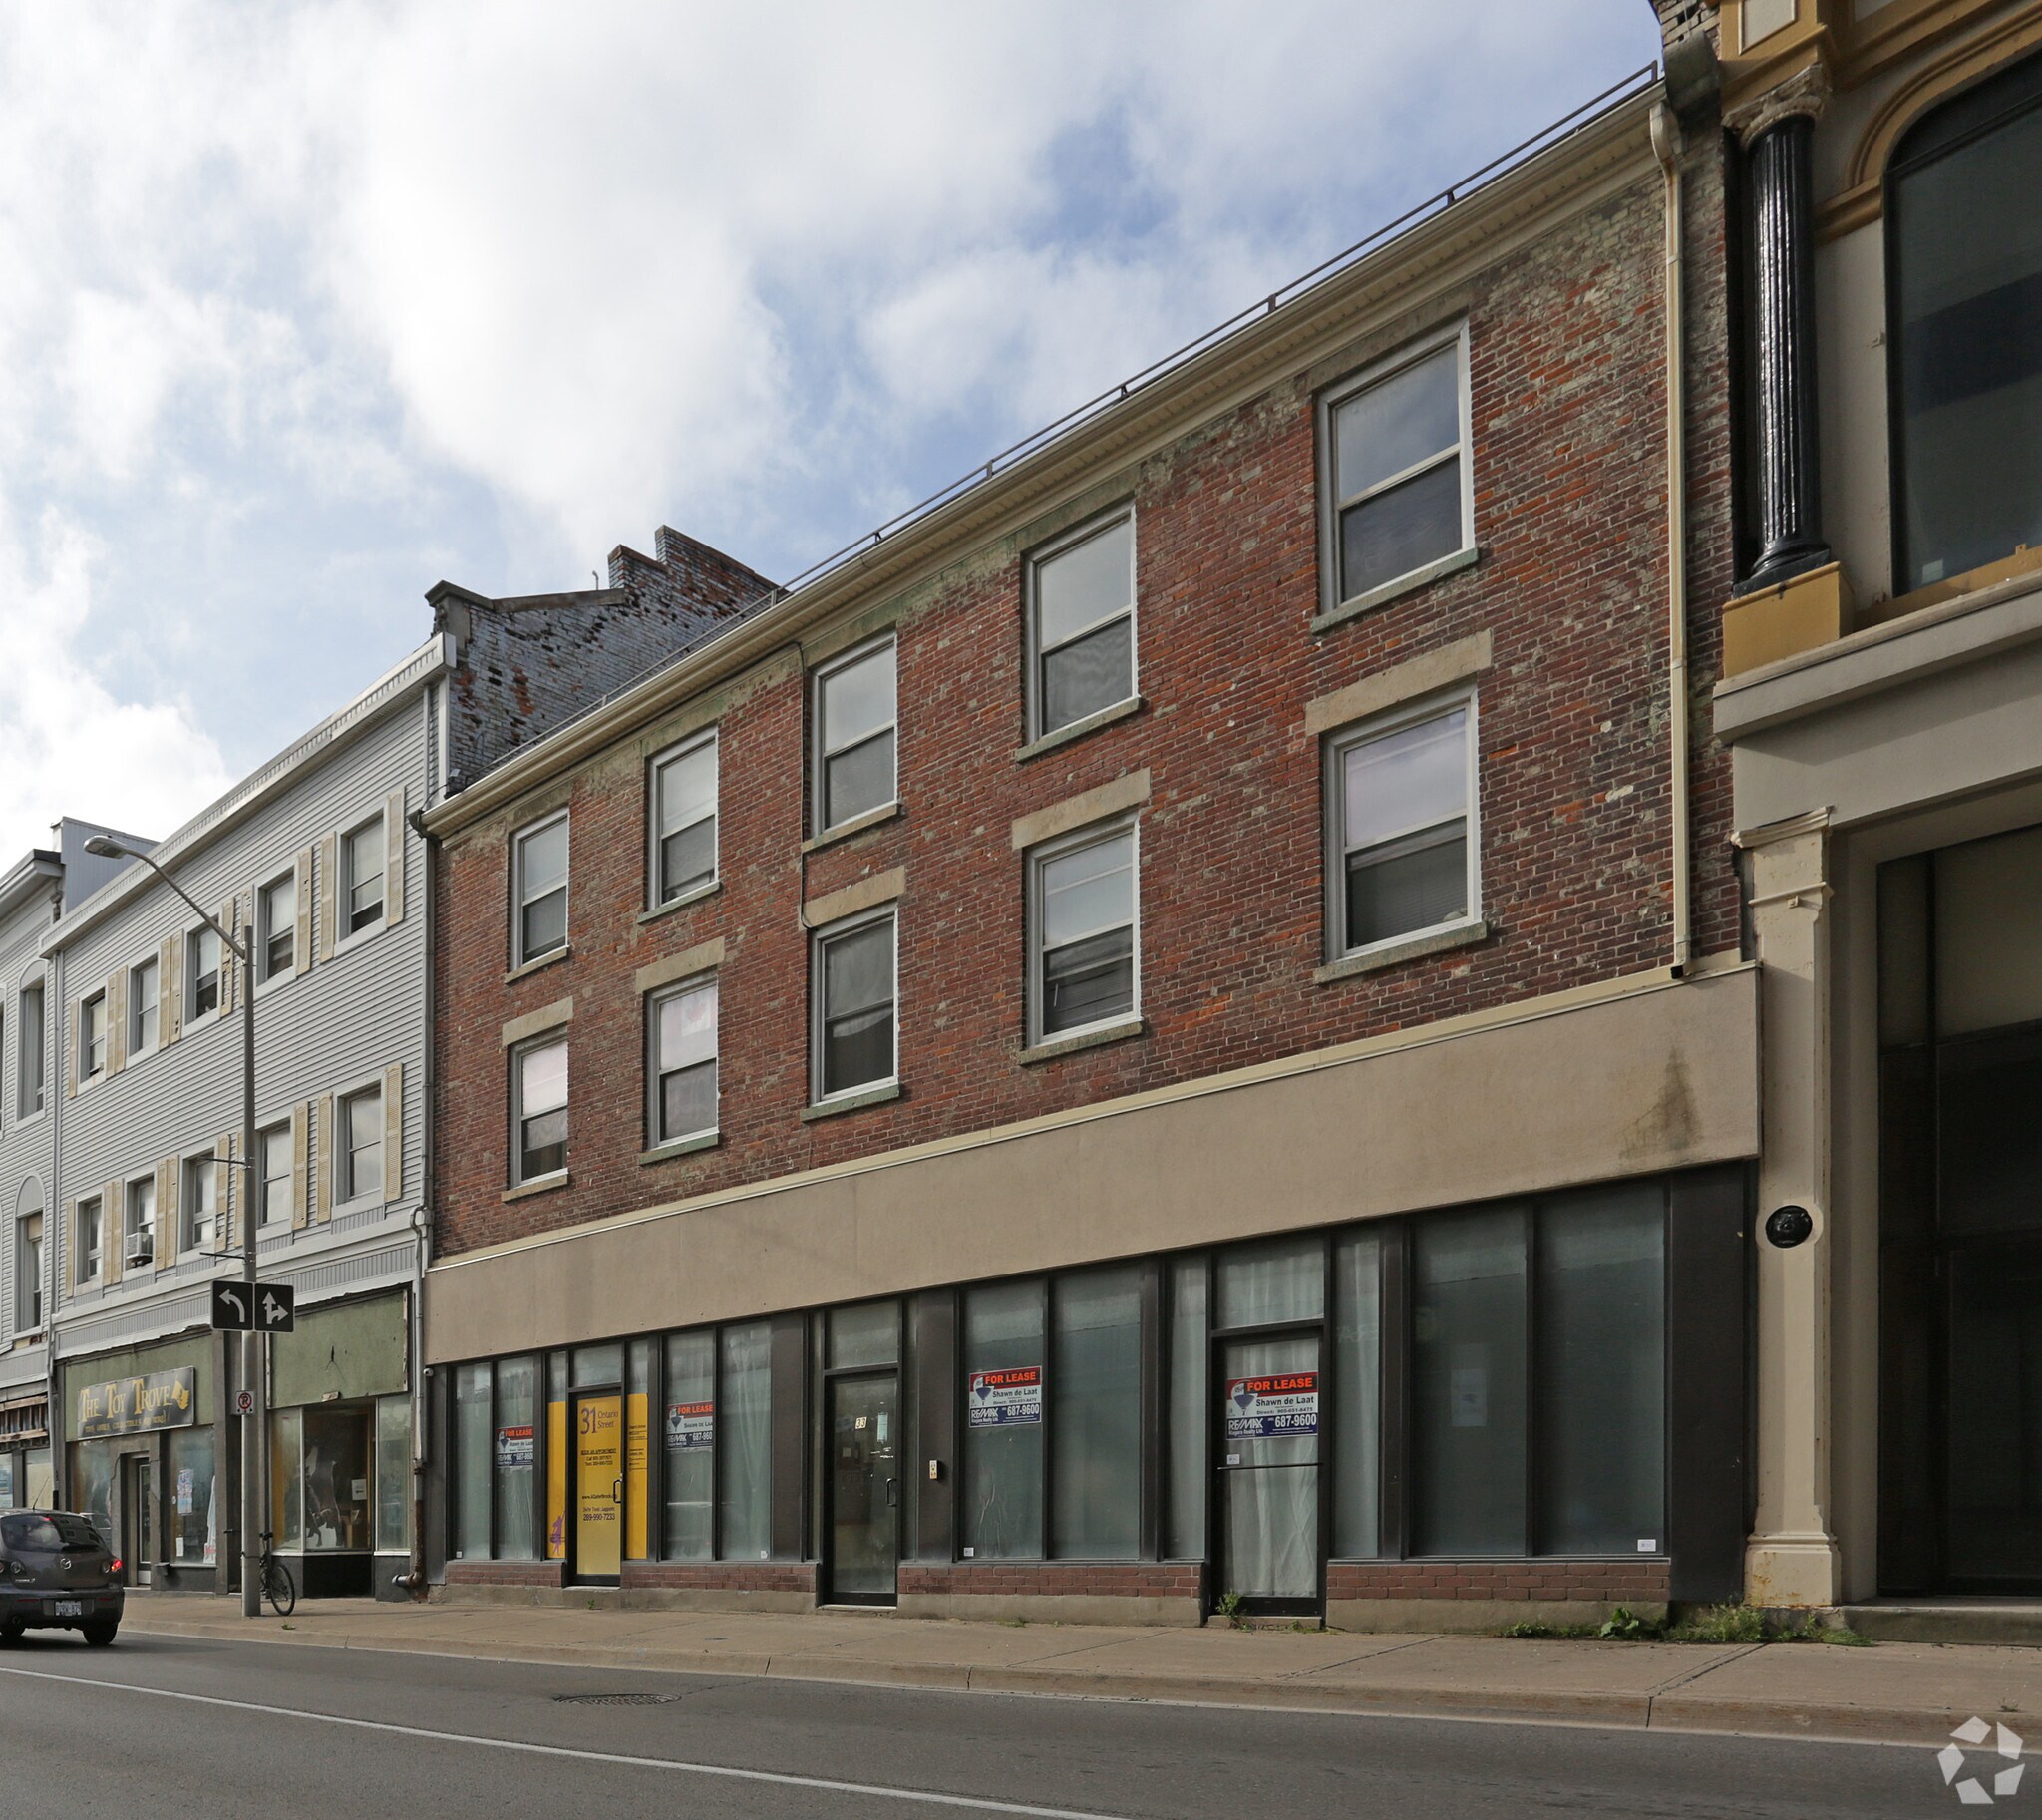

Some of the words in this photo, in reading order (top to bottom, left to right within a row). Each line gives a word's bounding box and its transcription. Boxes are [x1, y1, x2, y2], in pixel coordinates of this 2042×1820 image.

[985, 1375, 1003, 1384] FOR
[1006, 1372, 1037, 1383] LEASE
[1246, 1380, 1271, 1392] FOR
[1274, 1377, 1313, 1390] LEASE
[131, 1378, 173, 1415] TROVE
[1255, 1398, 1282, 1407] Shawn
[1296, 1395, 1314, 1404] Laat
[692, 1404, 713, 1413] LEASE
[970, 1407, 999, 1419] RE/MAX
[1007, 1403, 1040, 1416] 687-9600
[580, 1406, 597, 1435] 31
[856, 1417, 866, 1427] 33
[1227, 1417, 1264, 1431] RE/MAX
[1274, 1413, 1316, 1428] 687-9600
